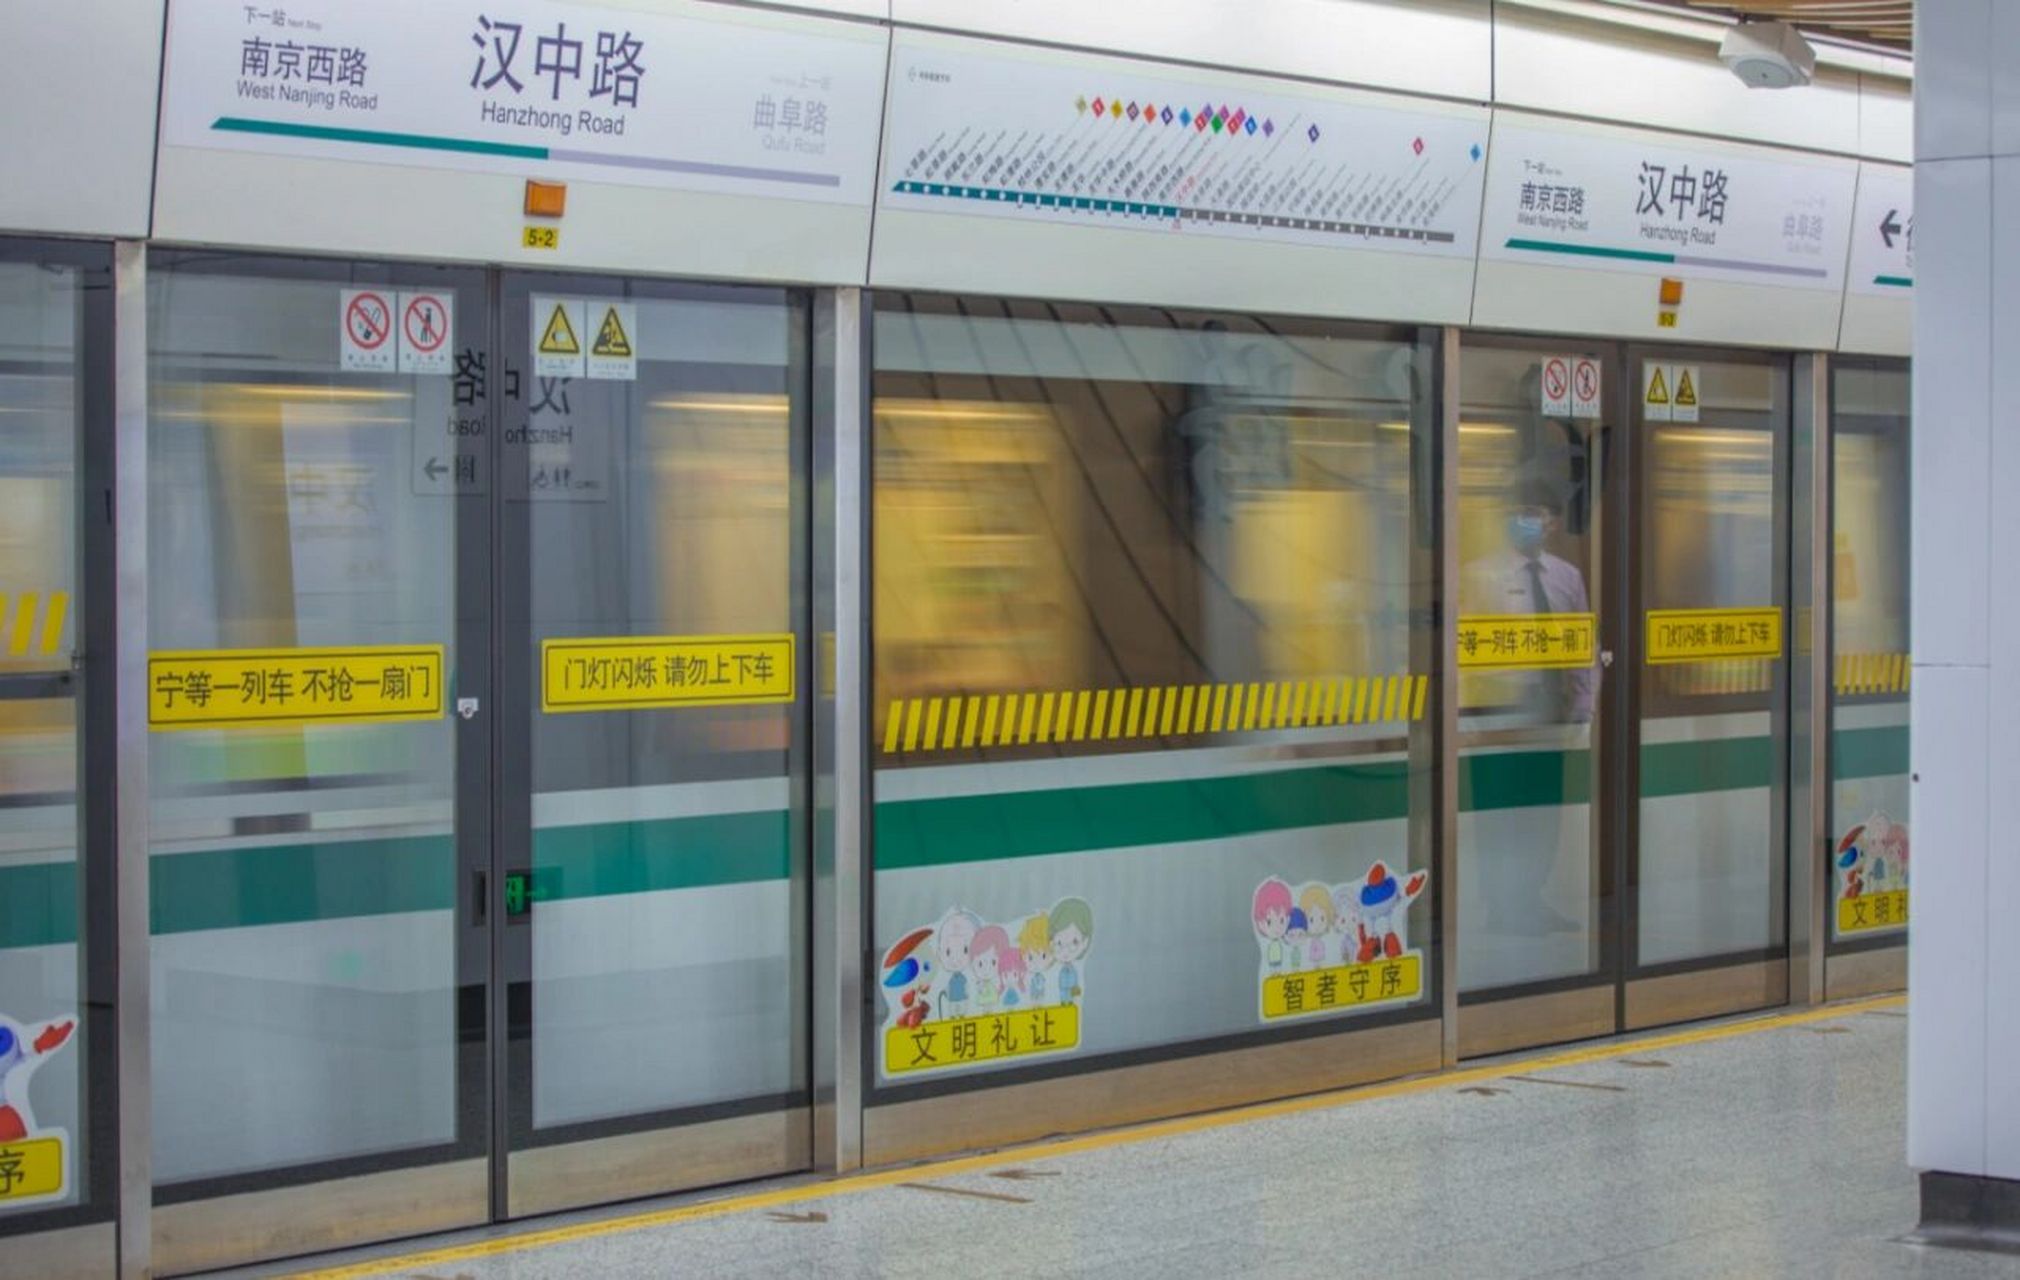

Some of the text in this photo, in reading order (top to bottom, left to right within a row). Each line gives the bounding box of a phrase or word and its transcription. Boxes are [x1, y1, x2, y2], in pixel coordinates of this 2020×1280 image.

[241, 36, 367, 87] 南京西路
[470, 14, 646, 108] 汉中路
[237, 79, 378, 110] West Nanjing Road
[752, 93, 828, 136] 曲阜路
[481, 100, 625, 136] Hanzhong Road
[1520, 180, 1584, 216] 南京西路
[1635, 160, 1729, 225] 汉中路
[1640, 221, 1716, 246] Hanzhong Road
[1658, 622, 1770, 648] 门灯闪烁 请勿上下车
[156, 665, 431, 708] 宁等一列车 不抢一扇门
[564, 652, 774, 690] 门灯闪烁 请勿上下车
[1283, 960, 1402, 1012] 智者守序
[911, 1009, 1056, 1065] 文明礼让
